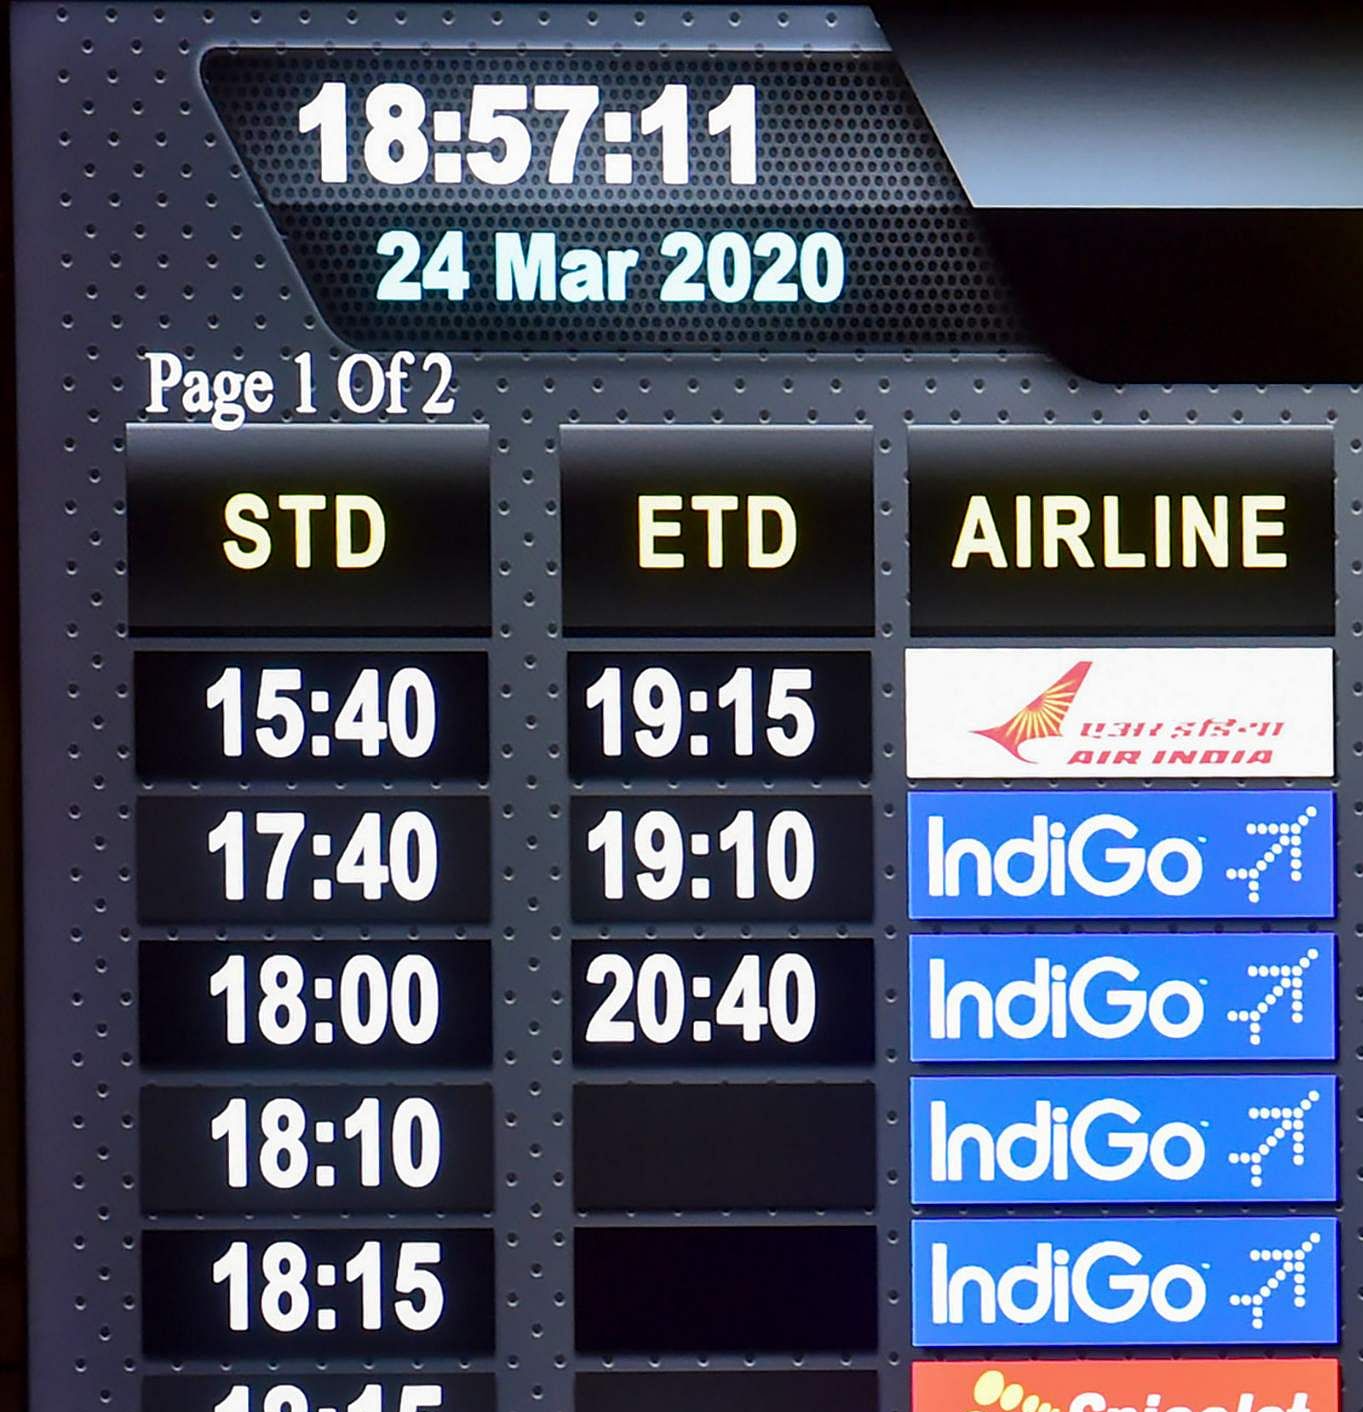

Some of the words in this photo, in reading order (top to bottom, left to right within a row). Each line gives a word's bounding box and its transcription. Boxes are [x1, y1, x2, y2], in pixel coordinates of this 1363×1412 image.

[298, 82, 757, 186] 18:57:11
[376, 230, 470, 301] 24
[495, 231, 639, 303] Mar
[659, 231, 845, 304] 2020
[144, 351, 274, 431] Page
[294, 351, 317, 414] 1
[337, 350, 416, 414] Of
[421, 352, 455, 414] 2
[223, 492, 386, 570] STD
[638, 495, 797, 569] ETD
[951, 495, 1287, 568] AIRLINE
[206, 667, 436, 758] 15:40
[586, 667, 815, 758] 19:15
[1067, 750, 1142, 765] AIR
[1151, 749, 1273, 765] INDIA
[208, 811, 438, 901] 17:40
[588, 810, 815, 901] 19:10
[928, 813, 1203, 898] IndiGo
[210, 954, 439, 1045] 18:00
[585, 953, 816, 1044] 20:40
[929, 956, 1205, 1040] IndiGo
[211, 1097, 441, 1189] 18:10
[930, 1098, 1206, 1182] IndiGo
[213, 1241, 444, 1332] 18:15
[931, 1240, 1207, 1324] IndiGo
